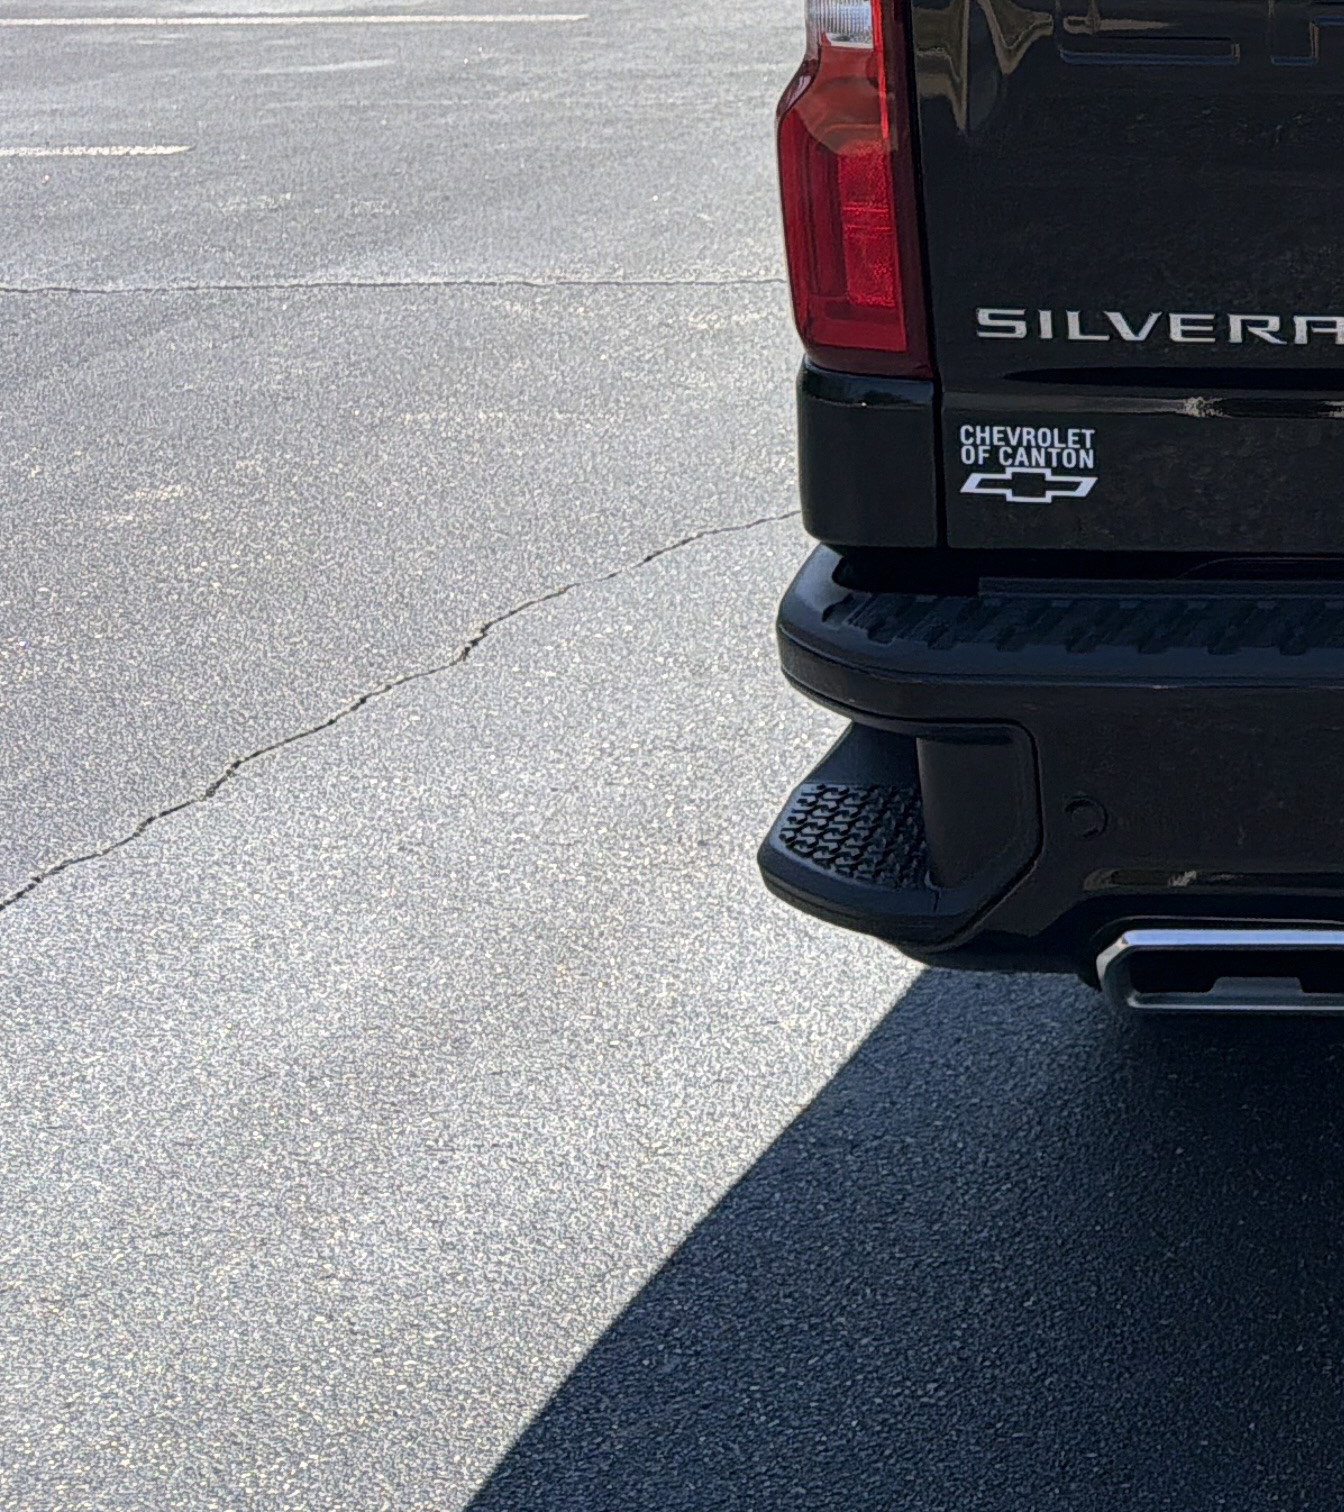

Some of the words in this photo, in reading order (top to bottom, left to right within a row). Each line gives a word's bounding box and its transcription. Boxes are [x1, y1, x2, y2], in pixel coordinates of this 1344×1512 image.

[959, 424, 1096, 450] CHEVROLET
[960, 445, 991, 466] OF
[998, 446, 1095, 469] CANTON
